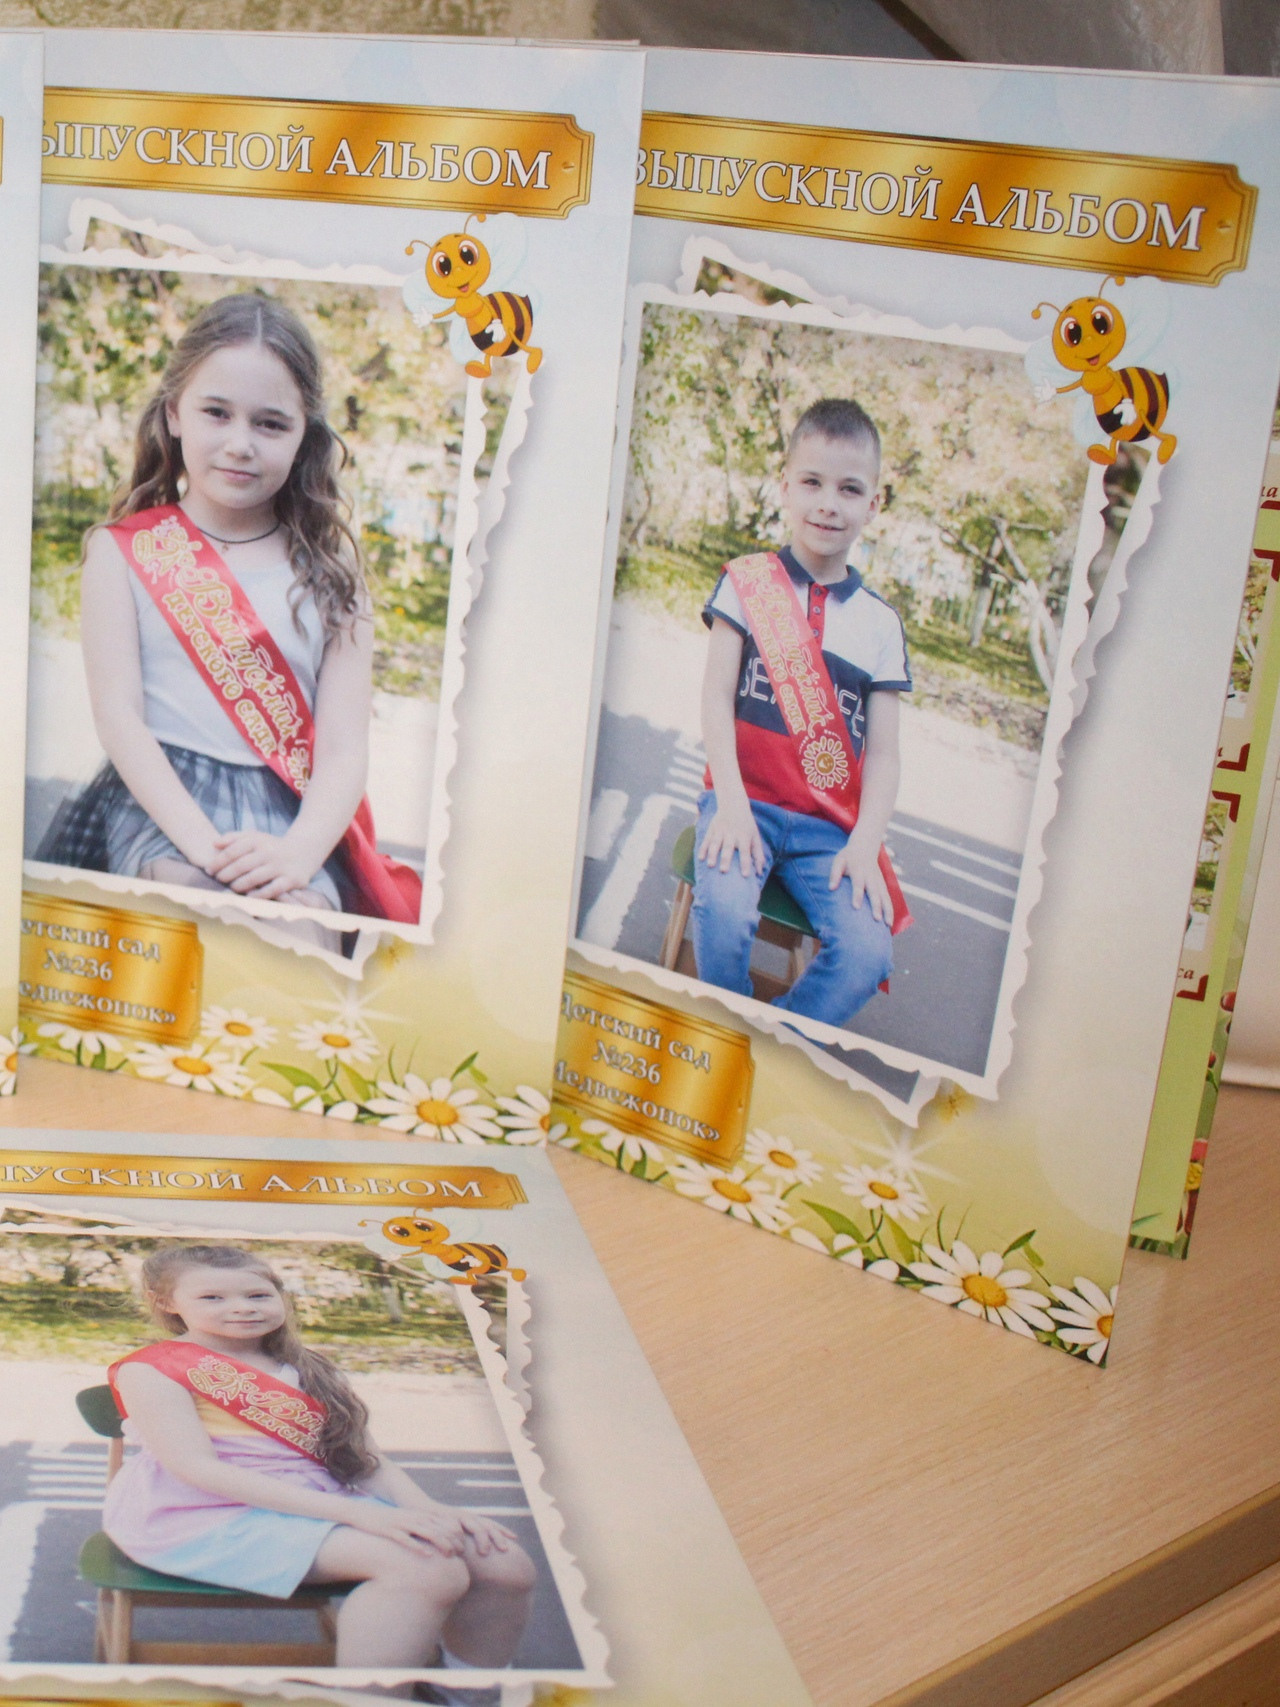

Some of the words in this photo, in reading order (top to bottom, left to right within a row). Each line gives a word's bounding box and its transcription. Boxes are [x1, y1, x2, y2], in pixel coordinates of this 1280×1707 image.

[325, 140, 552, 189] АЛЬБОМ
[951, 181, 1208, 252] АЛЬБОМ
[43, 948, 113, 981] №236
[117, 936, 161, 963] сад
[592, 1038, 661, 1084] №236
[668, 1039, 711, 1073] сад
[261, 1173, 488, 1199] АЛЬБОМ
